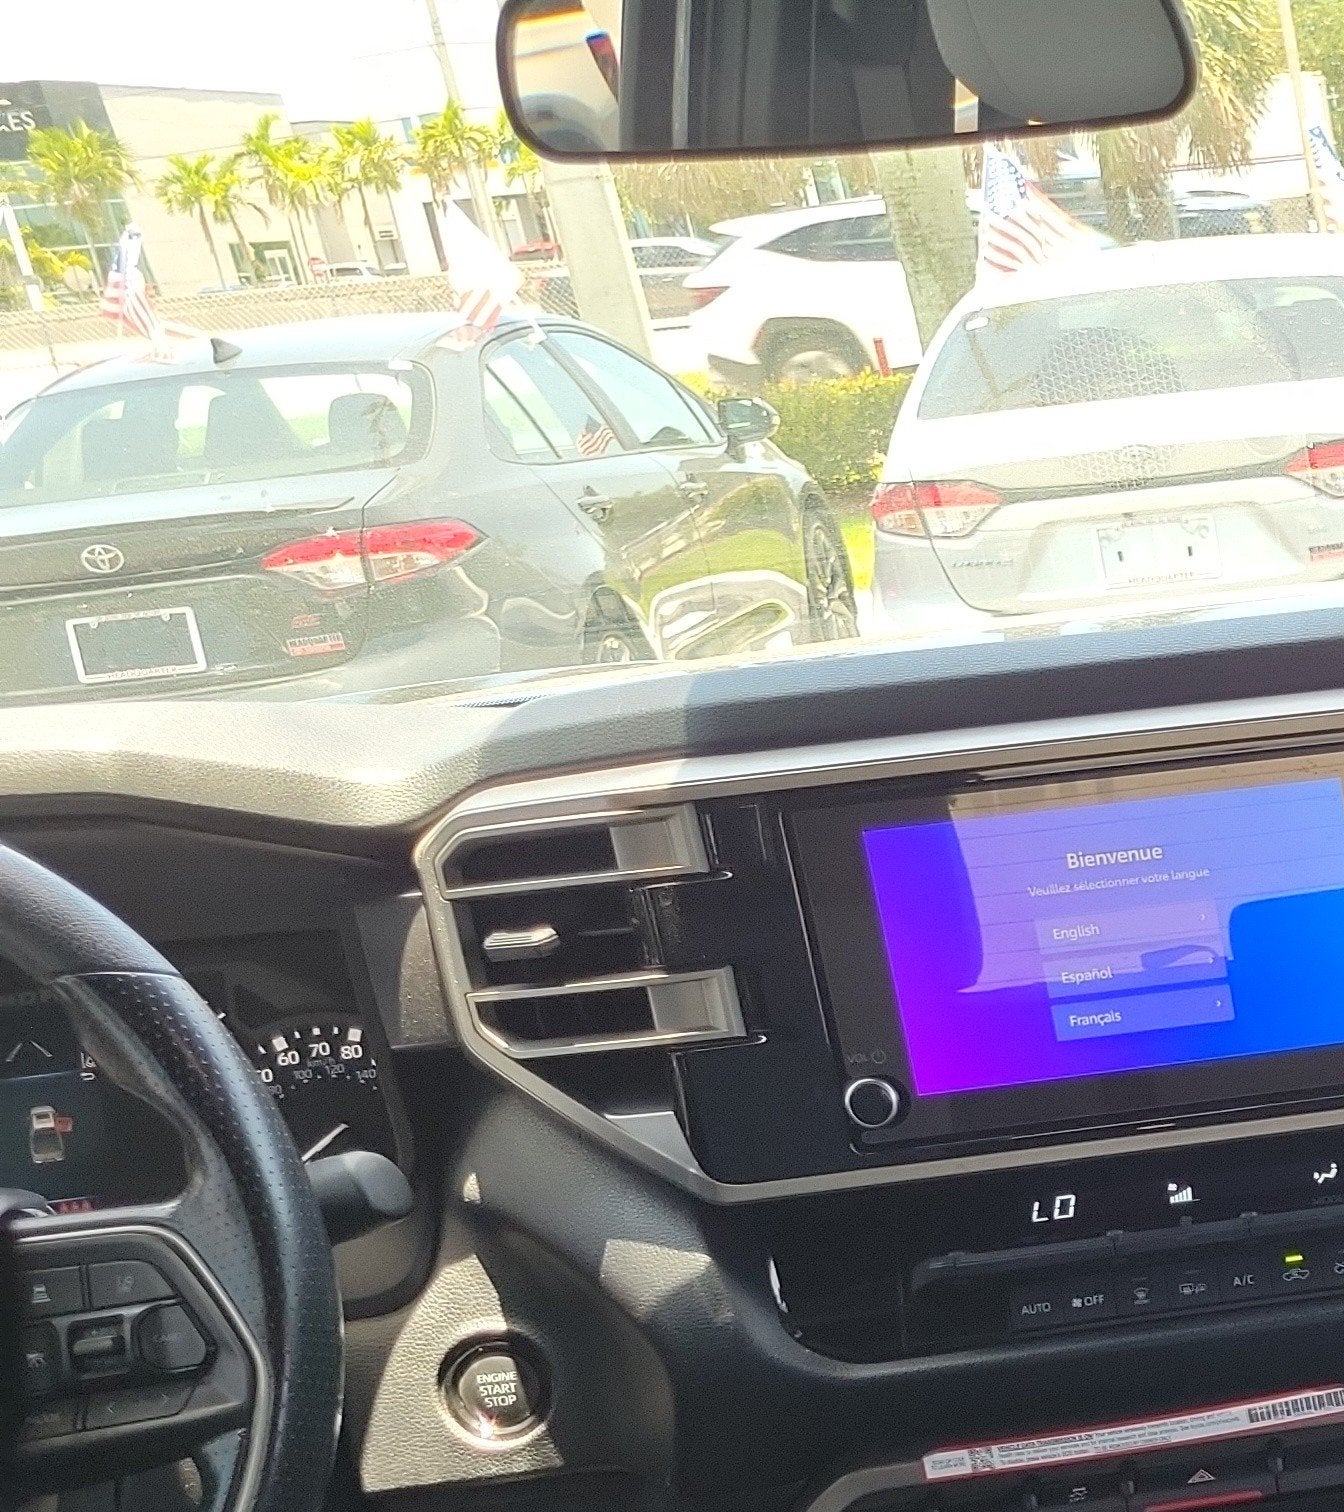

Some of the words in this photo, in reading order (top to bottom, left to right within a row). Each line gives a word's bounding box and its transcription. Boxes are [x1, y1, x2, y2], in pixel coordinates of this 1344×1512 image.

[1066, 846, 1163, 869] Bienvenue
[1027, 885, 1072, 897] Veuillez
[1141, 873, 1170, 884] votre
[1171, 868, 1210, 882] langue
[1052, 924, 1100, 941] English
[1061, 966, 1113, 985] Español
[1069, 1011, 1122, 1027] Français
[277, 1050, 300, 1066] 60
[308, 1042, 330, 1058] 70
[341, 1044, 363, 1060] 80
[1233, 1274, 1255, 1287] A/C
[1021, 1301, 1051, 1316] AUTO
[1084, 1294, 1105, 1307] OFF
[476, 1371, 518, 1384] ENGINE
[479, 1382, 517, 1397] START
[484, 1394, 517, 1408] STOP
